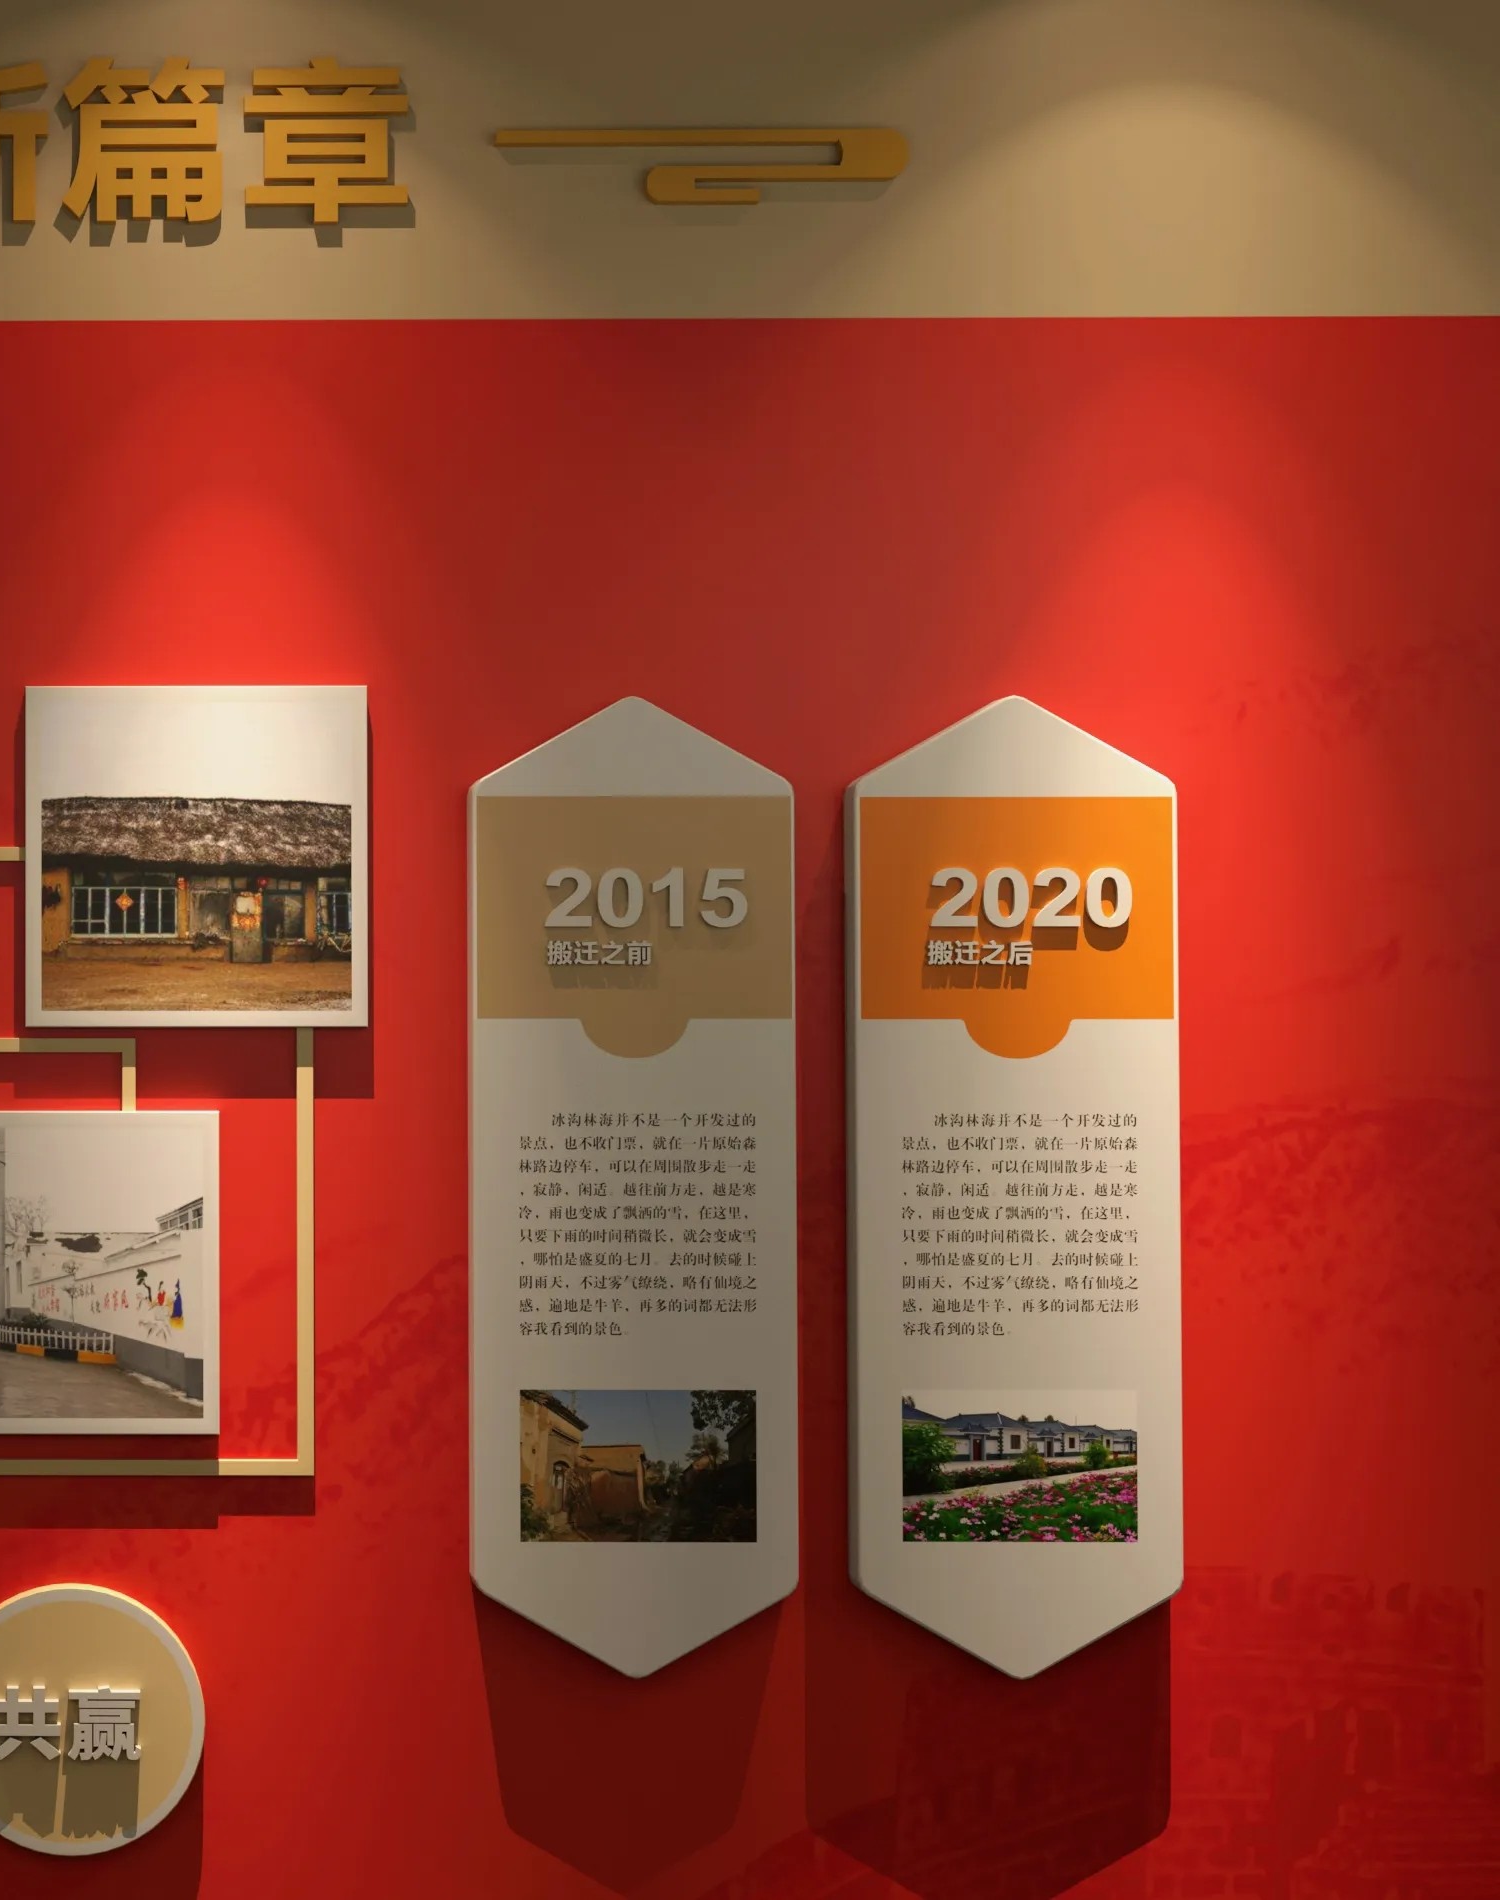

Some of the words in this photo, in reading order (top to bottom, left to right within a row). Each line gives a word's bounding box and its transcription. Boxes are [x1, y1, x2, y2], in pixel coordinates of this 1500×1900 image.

[545, 867, 748, 928] 2015
[930, 867, 1133, 928] 2020
[546, 941, 653, 966] 搬迁之前
[927, 940, 1034, 966] 搬迁之后
[551, 1112, 756, 1128] 冰沟林海并不是一个开发过的
[934, 1112, 1138, 1128] 冰沟林海并不是一个开发过的
